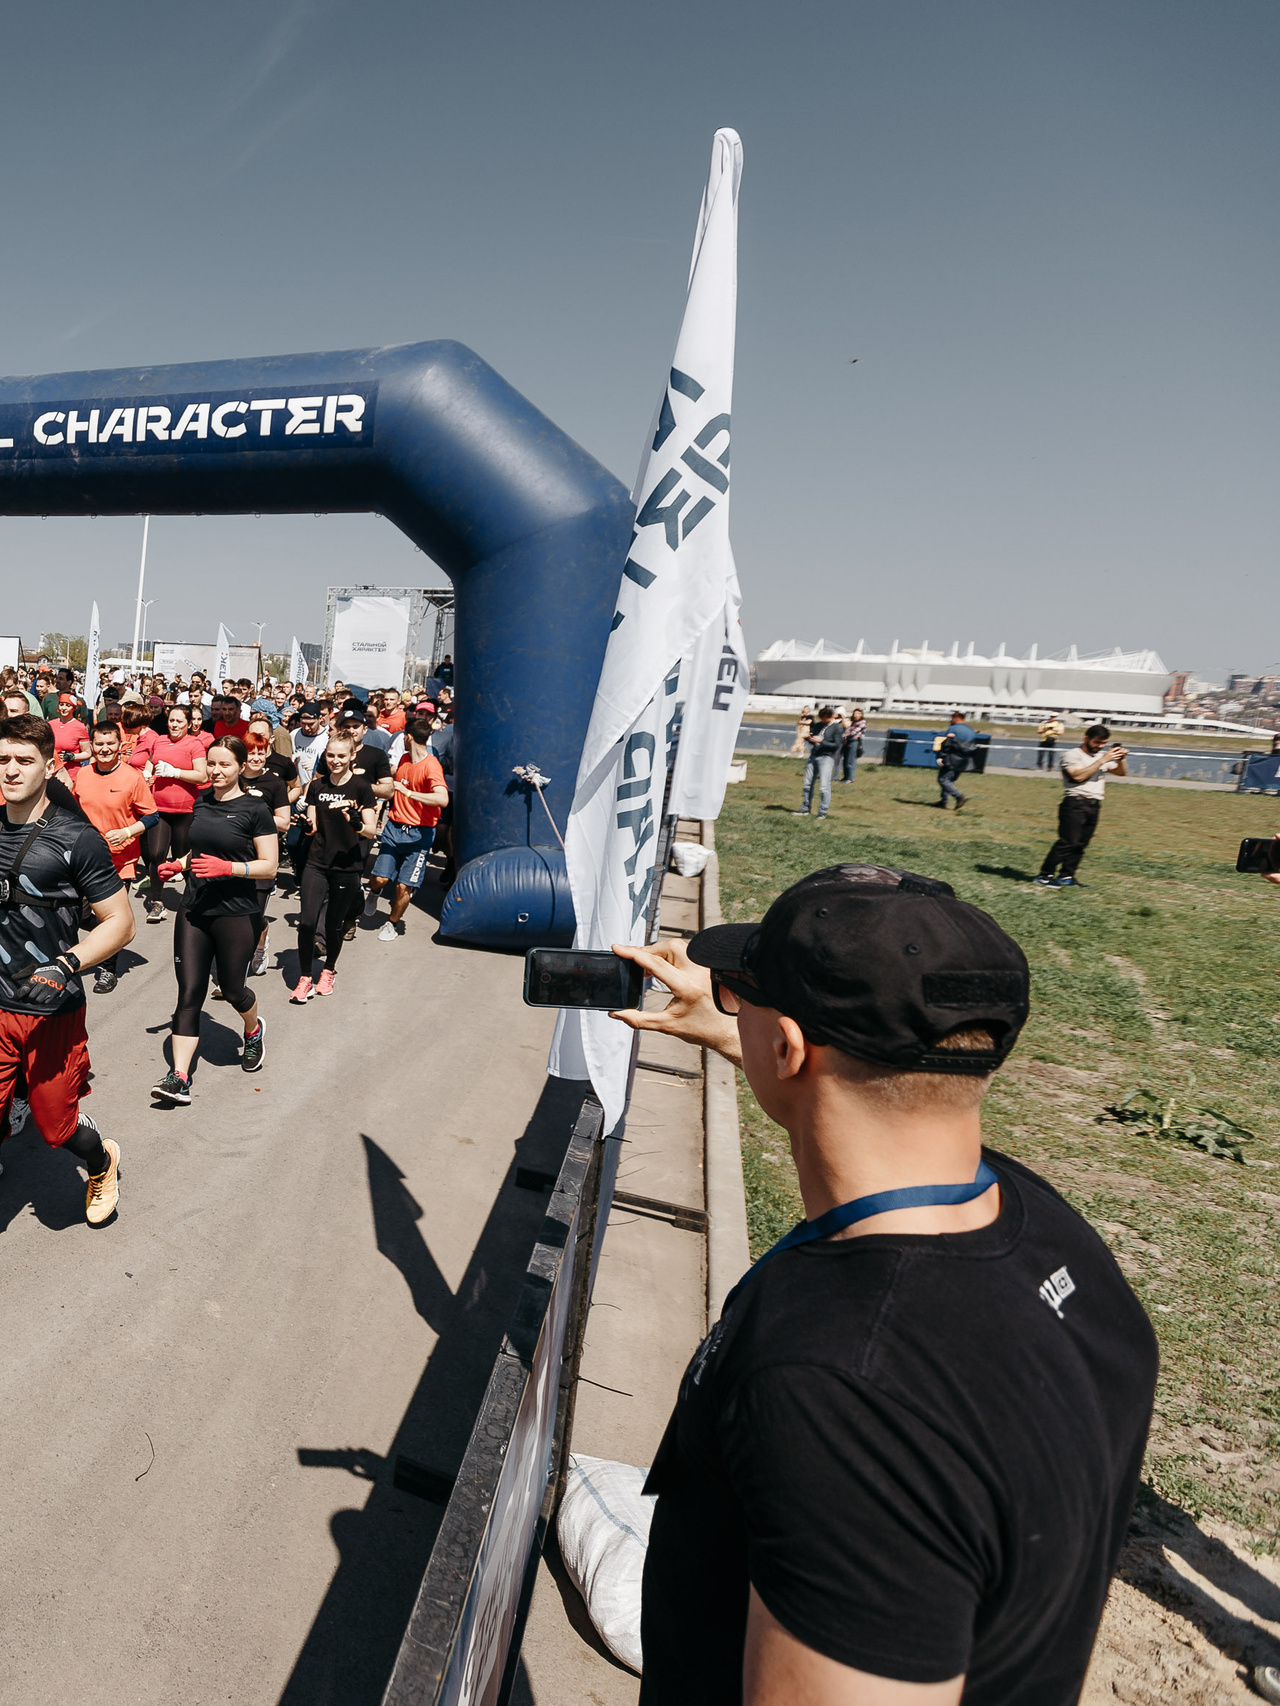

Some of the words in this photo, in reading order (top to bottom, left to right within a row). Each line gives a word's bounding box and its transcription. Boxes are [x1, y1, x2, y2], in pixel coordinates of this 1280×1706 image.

[33, 393, 366, 446] CHARACTER
[318, 792, 346, 802] CRAZY
[29, 974, 65, 991] ROGU
